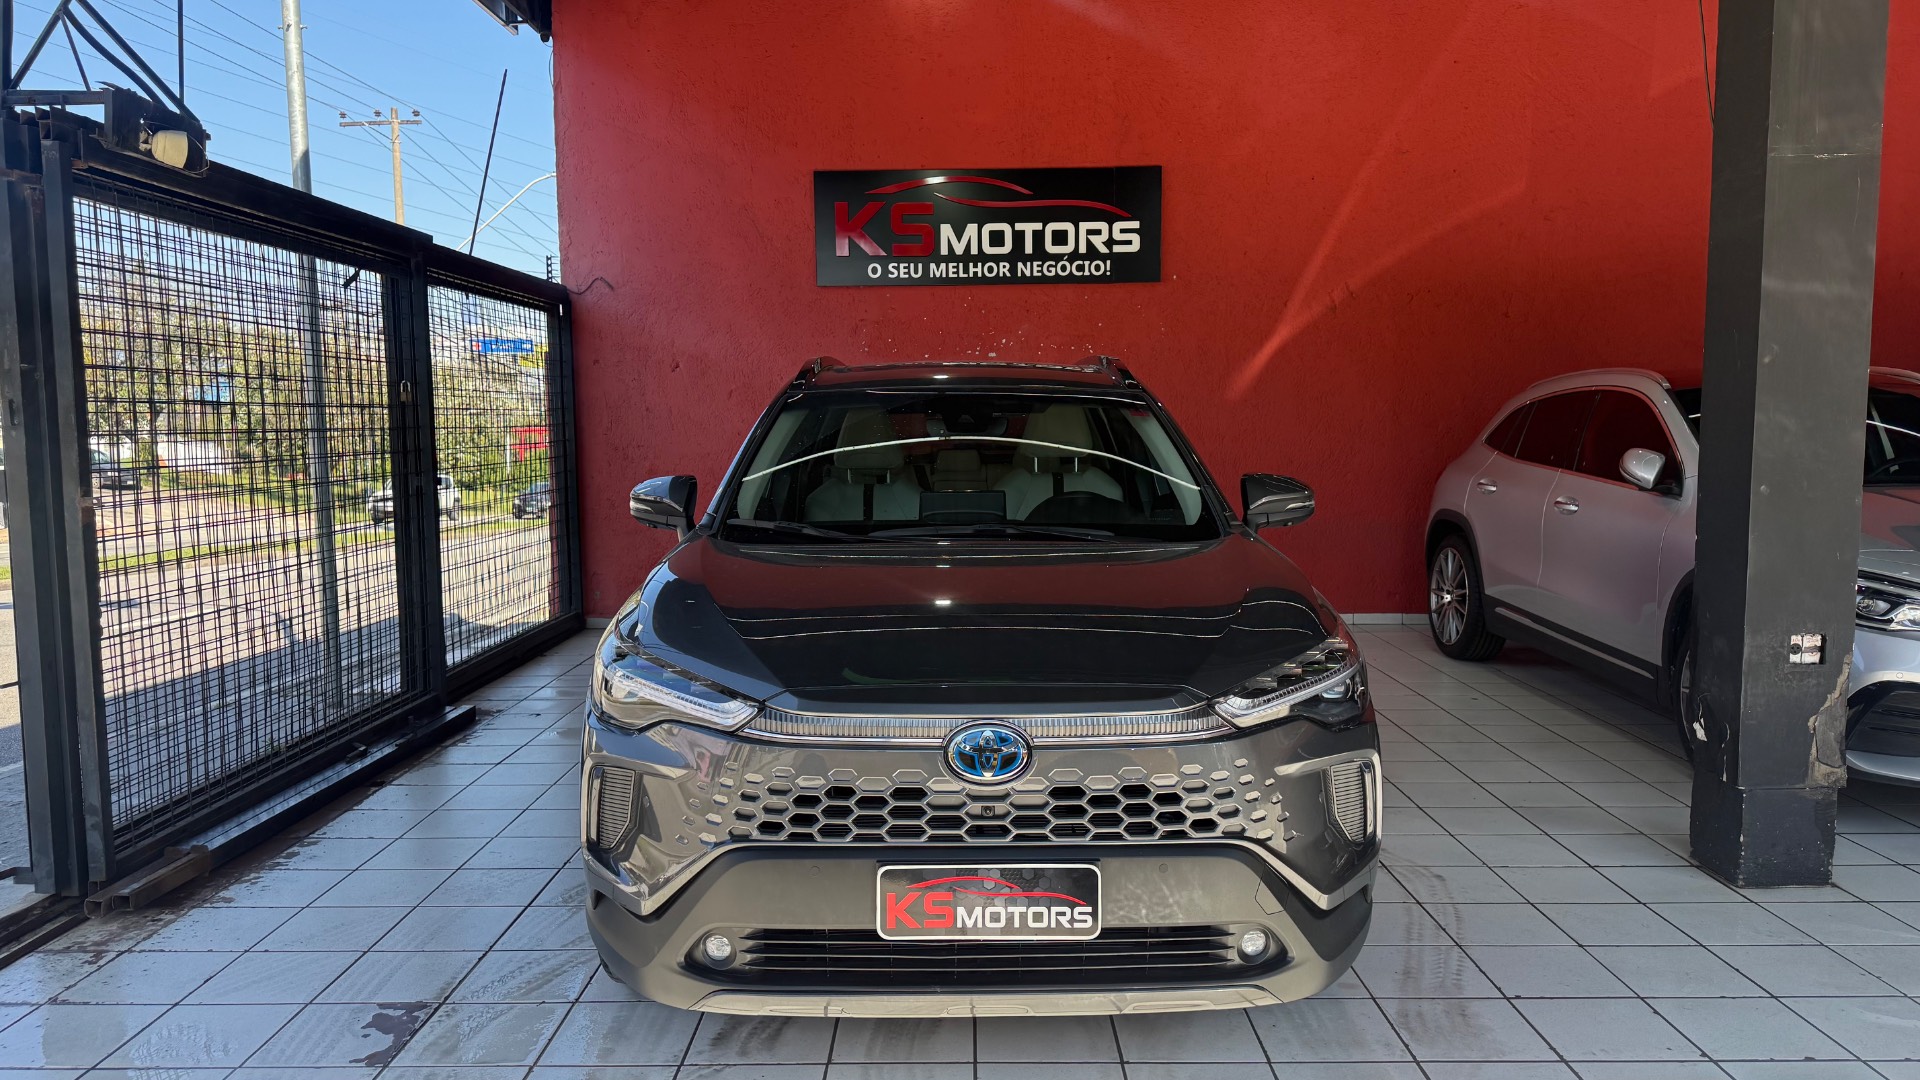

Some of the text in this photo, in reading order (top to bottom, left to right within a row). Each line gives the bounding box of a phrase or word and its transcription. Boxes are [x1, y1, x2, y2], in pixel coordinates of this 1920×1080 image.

[834, 202, 1141, 257] KS MOTORS
[867, 255, 1111, 278] O SEU MELHOR NEGÓCIO!
[886, 891, 1093, 929] KS MOTORS
